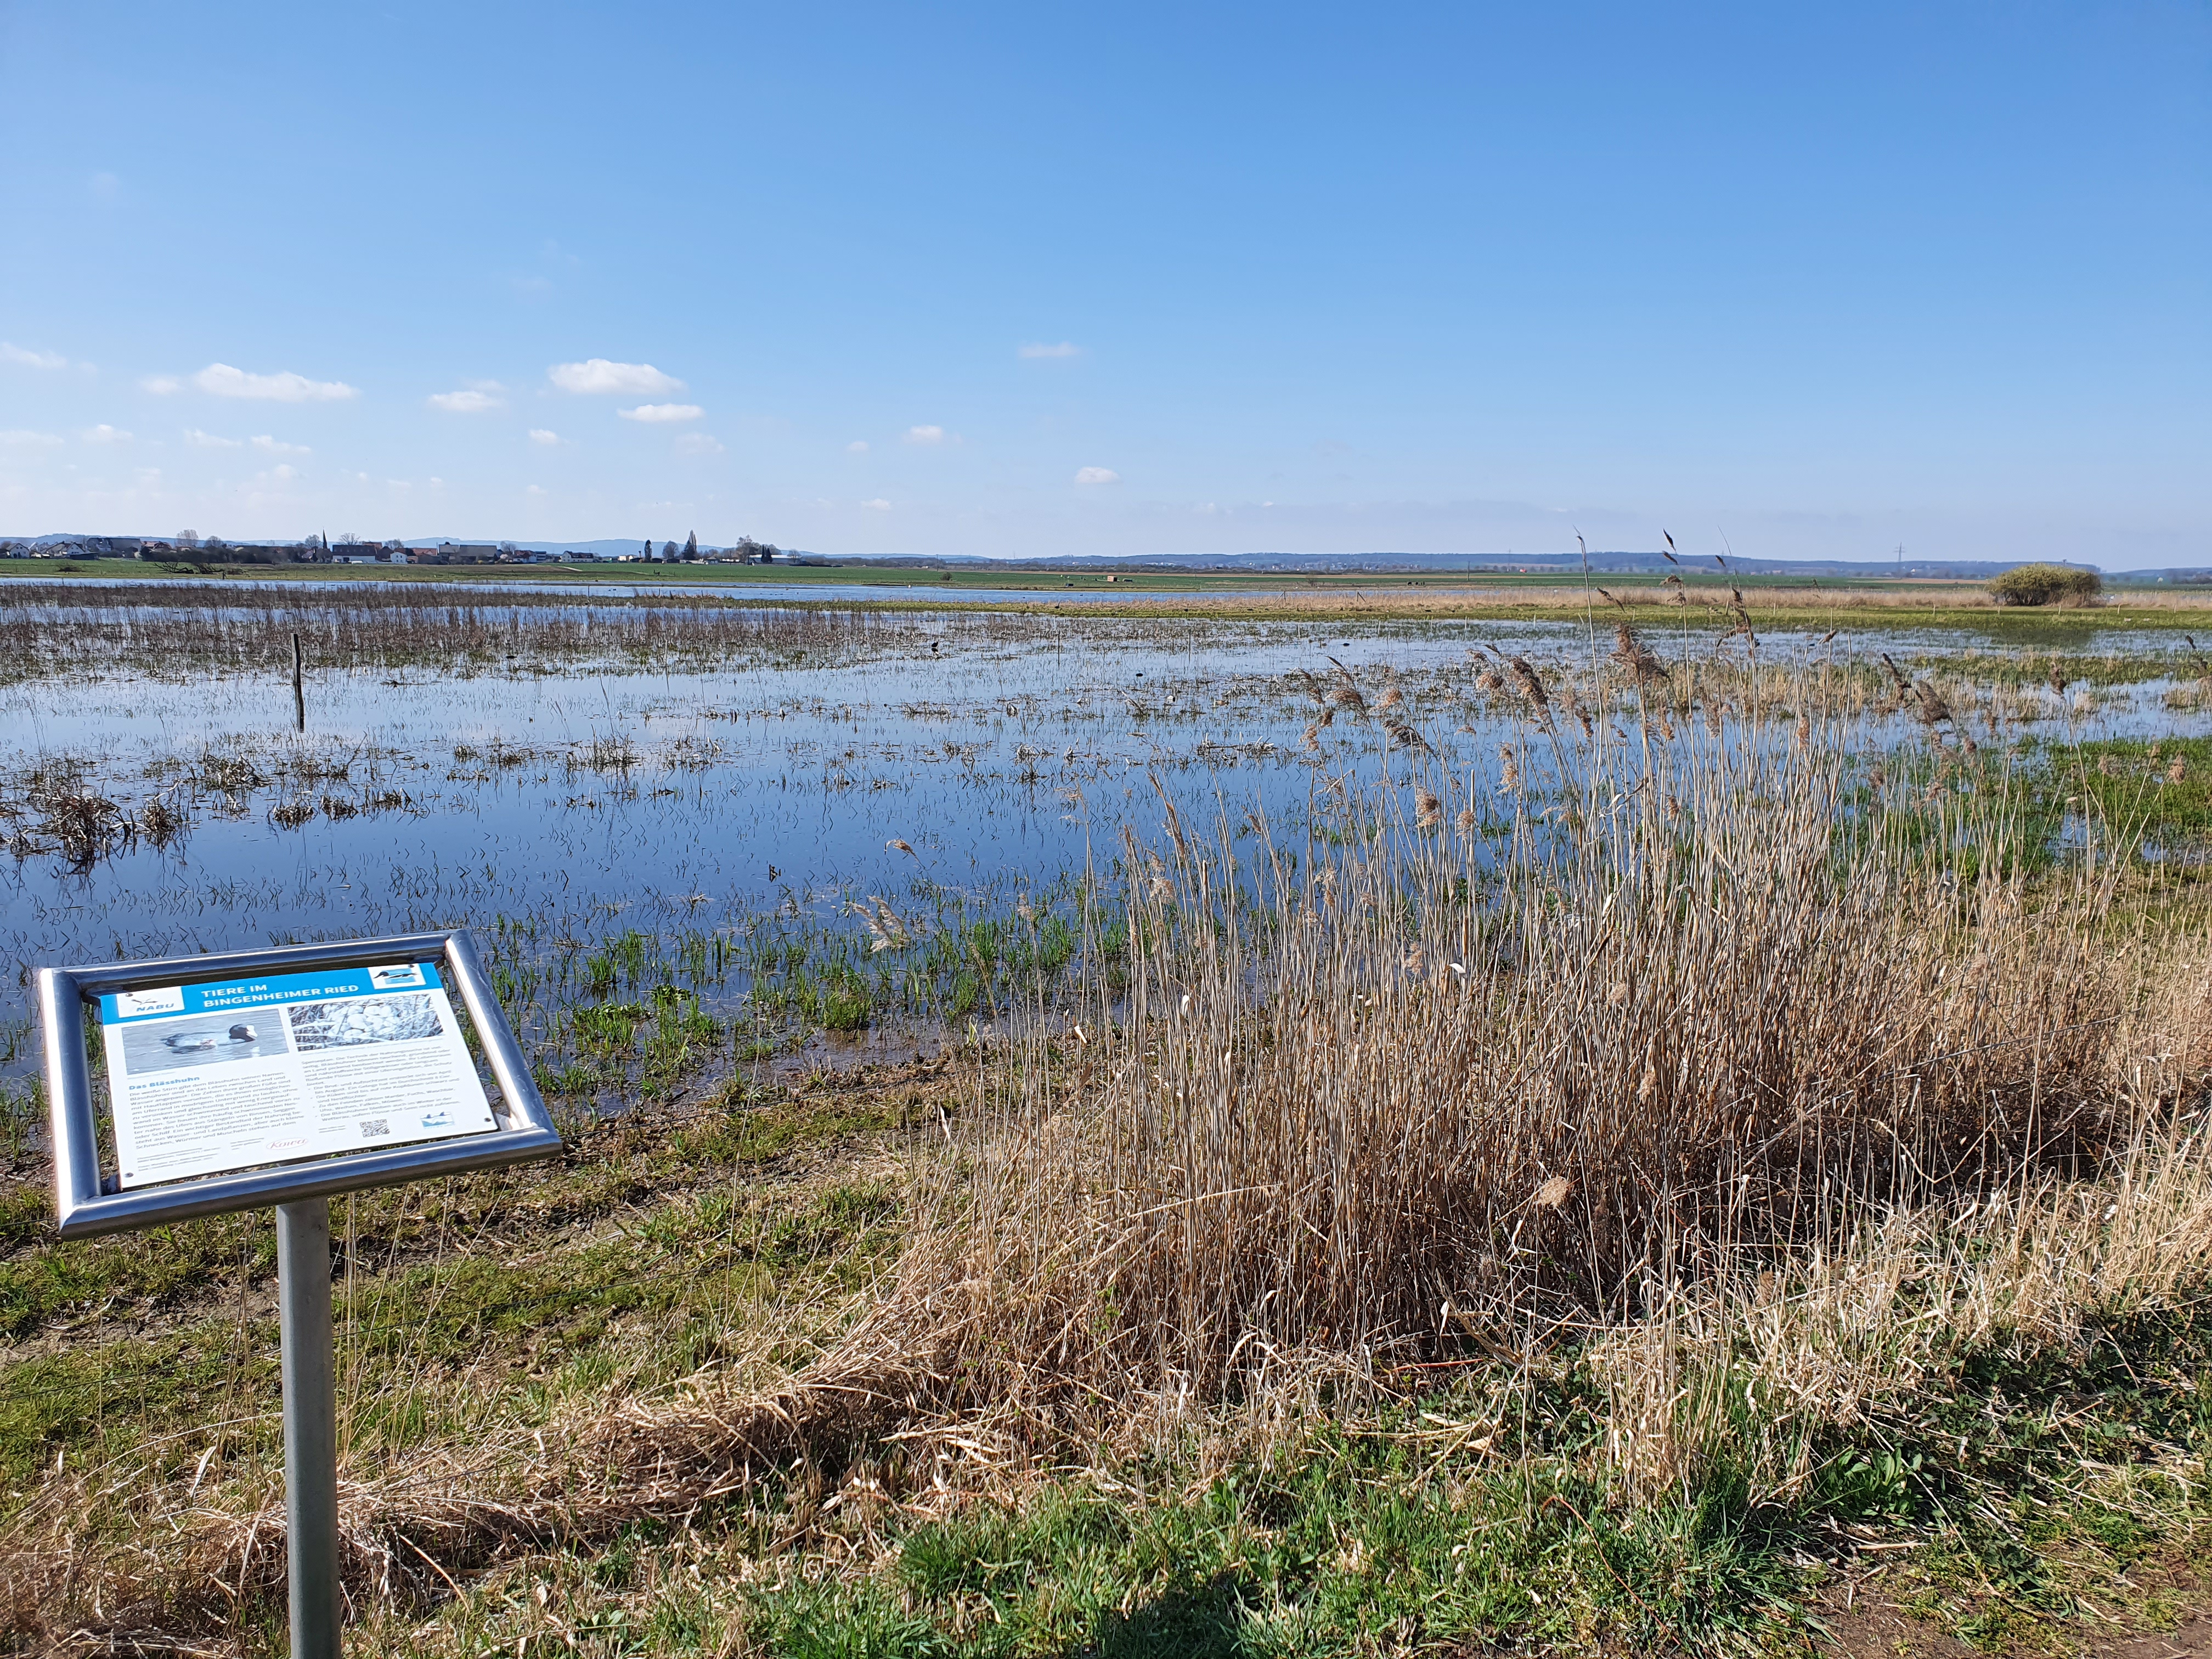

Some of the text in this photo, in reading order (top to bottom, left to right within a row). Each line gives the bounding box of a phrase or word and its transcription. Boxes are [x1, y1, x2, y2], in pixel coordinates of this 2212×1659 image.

[201, 984, 267, 998] TIERE IM
[204, 985, 359, 1007] BINGENHEIMER RIED
[137, 1003, 174, 1012] NABU
[149, 1077, 200, 1087] Blässhuhn
[270, 1139, 306, 1148] Kowa
